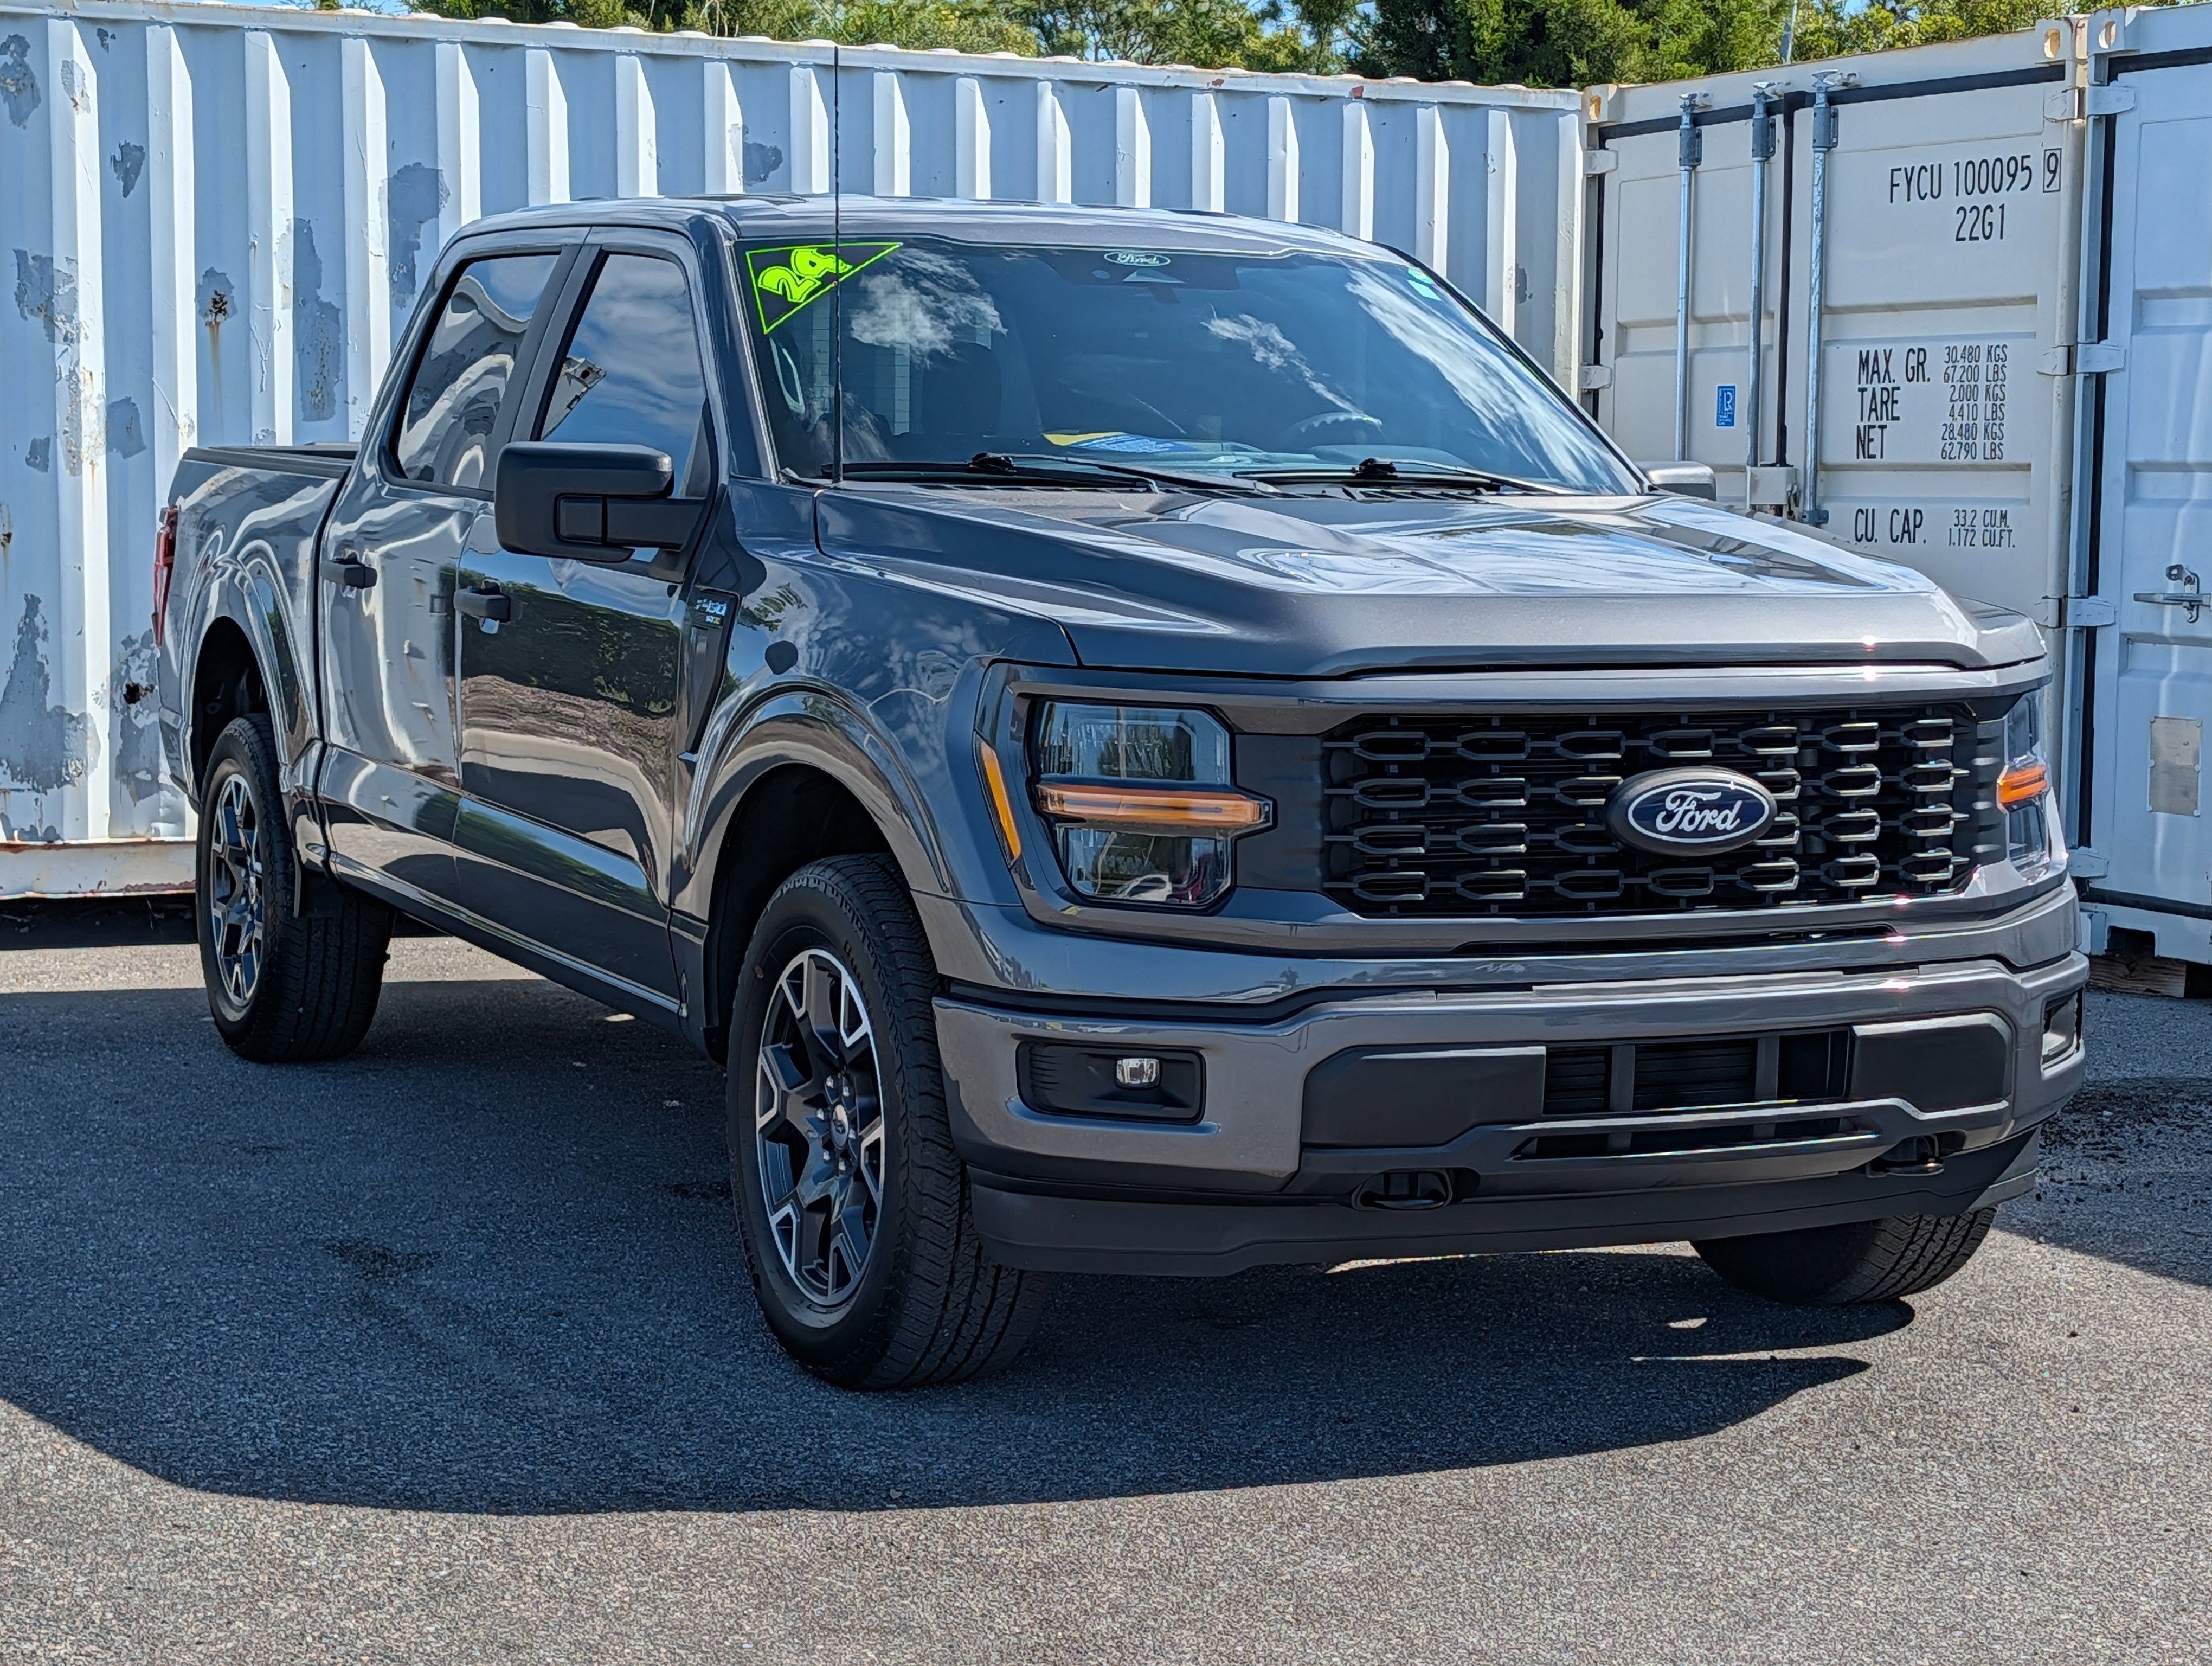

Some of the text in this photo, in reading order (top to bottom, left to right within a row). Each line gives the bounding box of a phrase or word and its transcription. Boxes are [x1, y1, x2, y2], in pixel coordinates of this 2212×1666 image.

[1890, 151, 2060, 203] FYCU 100095 9
[1955, 203, 2005, 242] 22G1
[1857, 347, 1931, 385] MAX. GR.
[1986, 344, 2008, 363] KGS
[1985, 363, 2007, 383] LBS
[1857, 386, 1901, 422] TARE
[1984, 383, 2006, 402] KGS
[1984, 403, 2005, 421] LBS
[1856, 424, 1888, 460] NET
[1983, 422, 2005, 441] KGS
[1983, 441, 2004, 460] LBS
[1854, 508, 1927, 544] CU. CAP.
[1656, 790, 1742, 832] Ford
